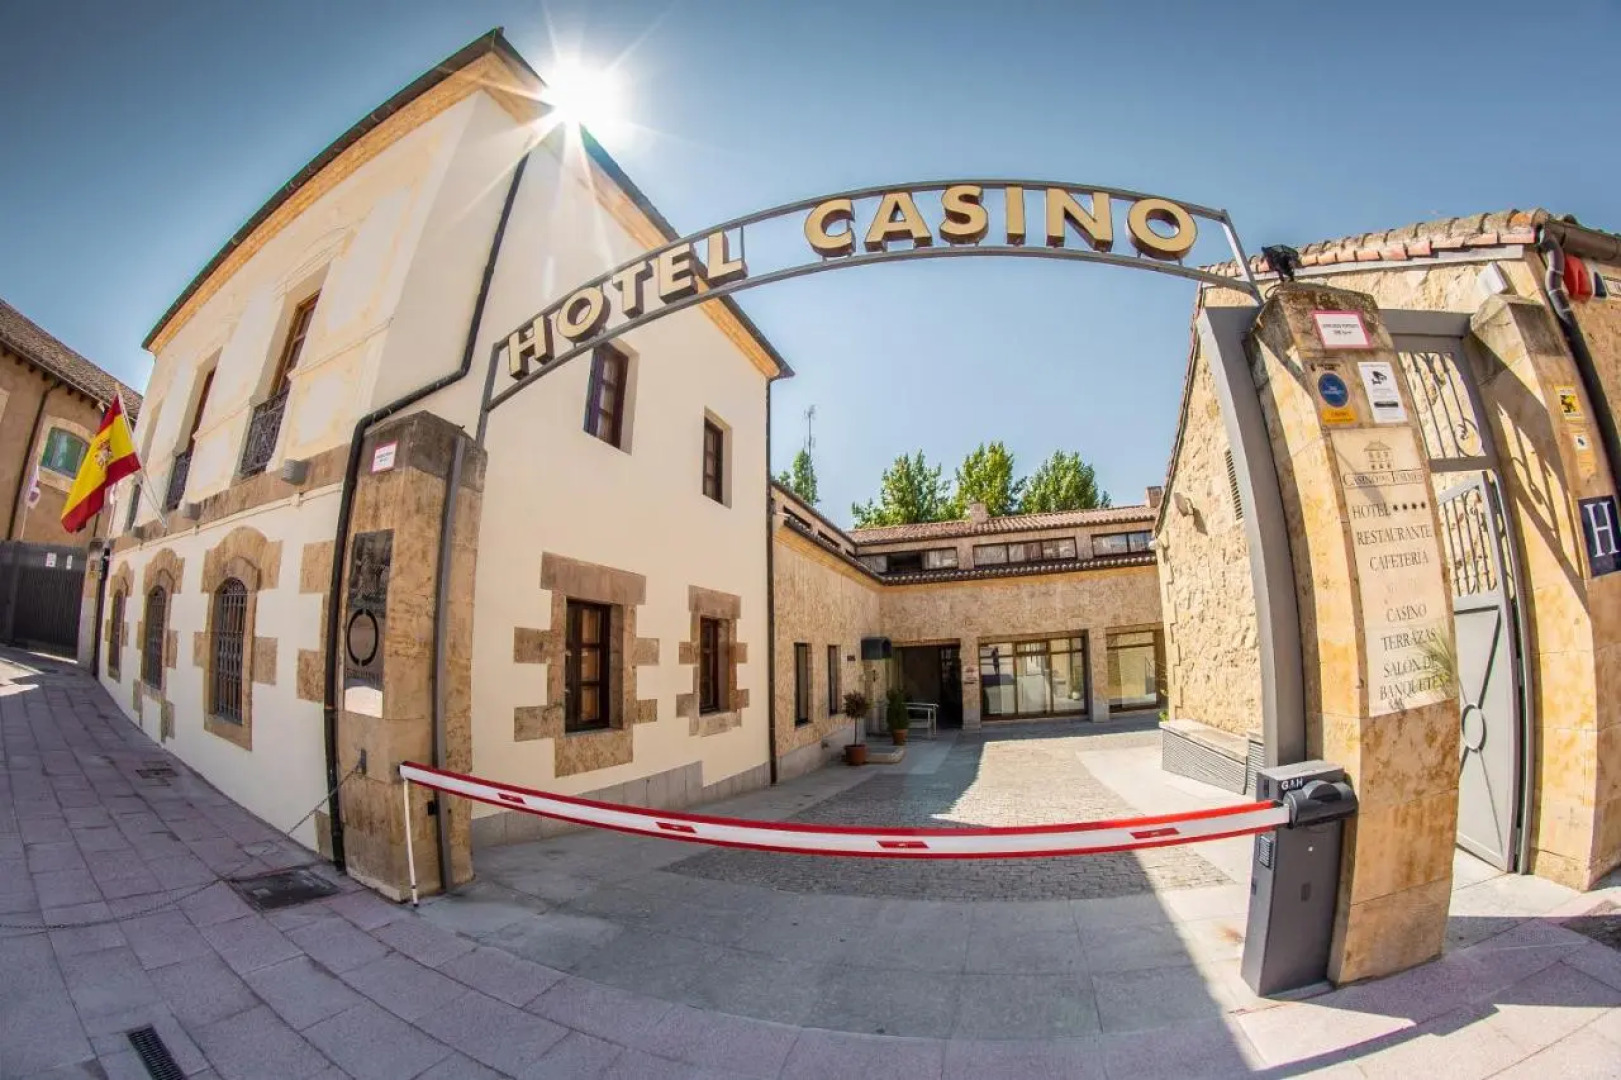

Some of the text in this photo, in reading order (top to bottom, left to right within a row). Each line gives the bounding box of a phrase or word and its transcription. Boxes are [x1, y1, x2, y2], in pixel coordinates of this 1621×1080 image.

[508, 183, 1199, 381] HOTEL CASINO
[1351, 503, 1391, 519] HOTEL
[1356, 524, 1433, 546] RESTAURANTE
[1584, 501, 1620, 558] H
[1386, 603, 1427, 622] CASINO
[1380, 627, 1437, 651] TERRAZAS
